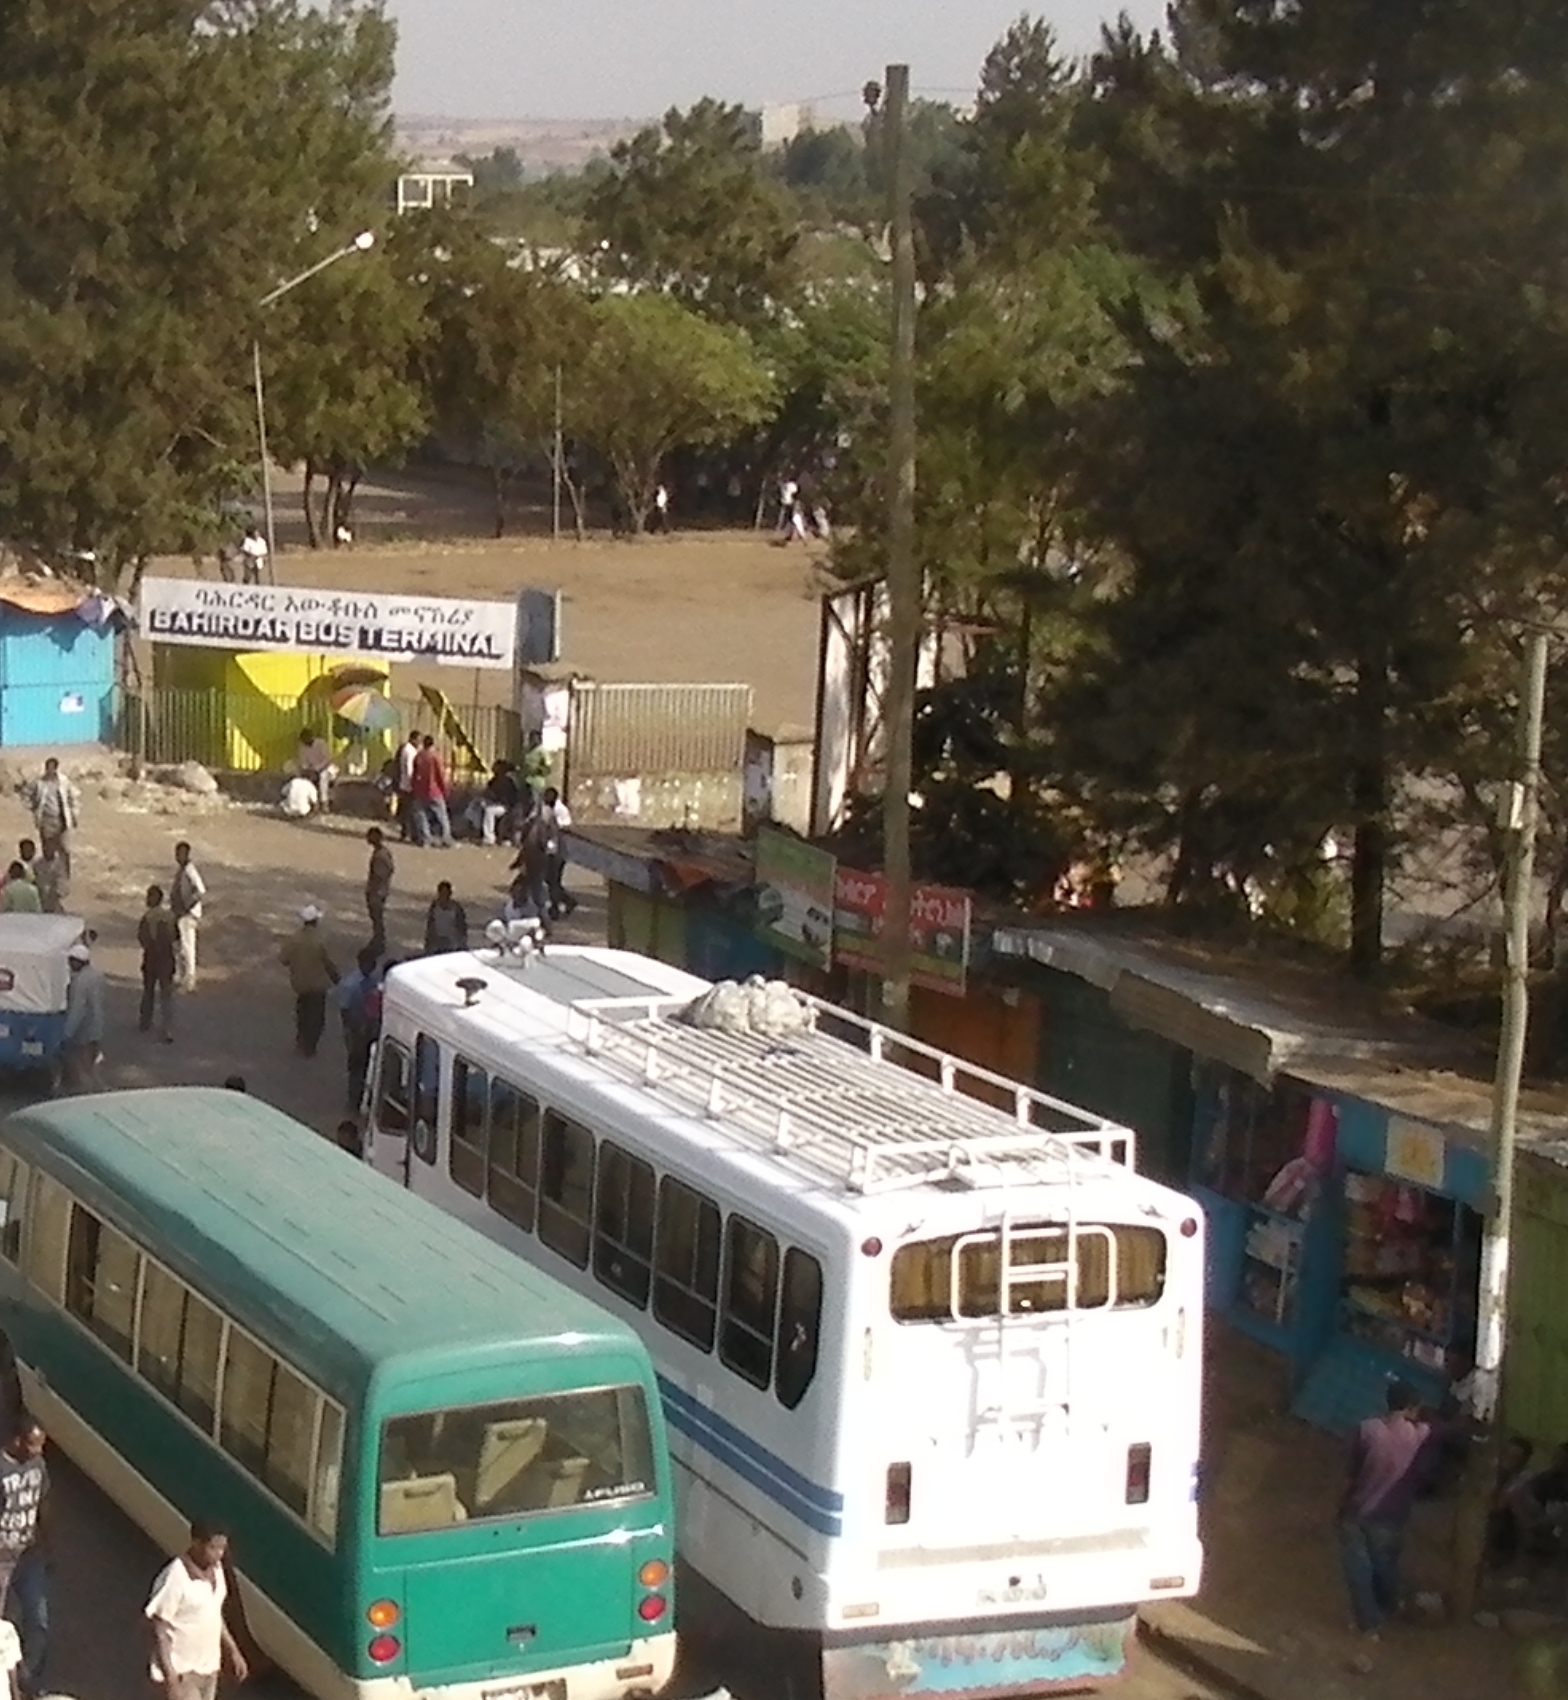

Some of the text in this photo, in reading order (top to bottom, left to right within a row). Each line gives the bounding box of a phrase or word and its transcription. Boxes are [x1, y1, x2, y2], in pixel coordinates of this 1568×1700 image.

[150, 607, 505, 660] BAHIRDAR BUS TERMINAL
